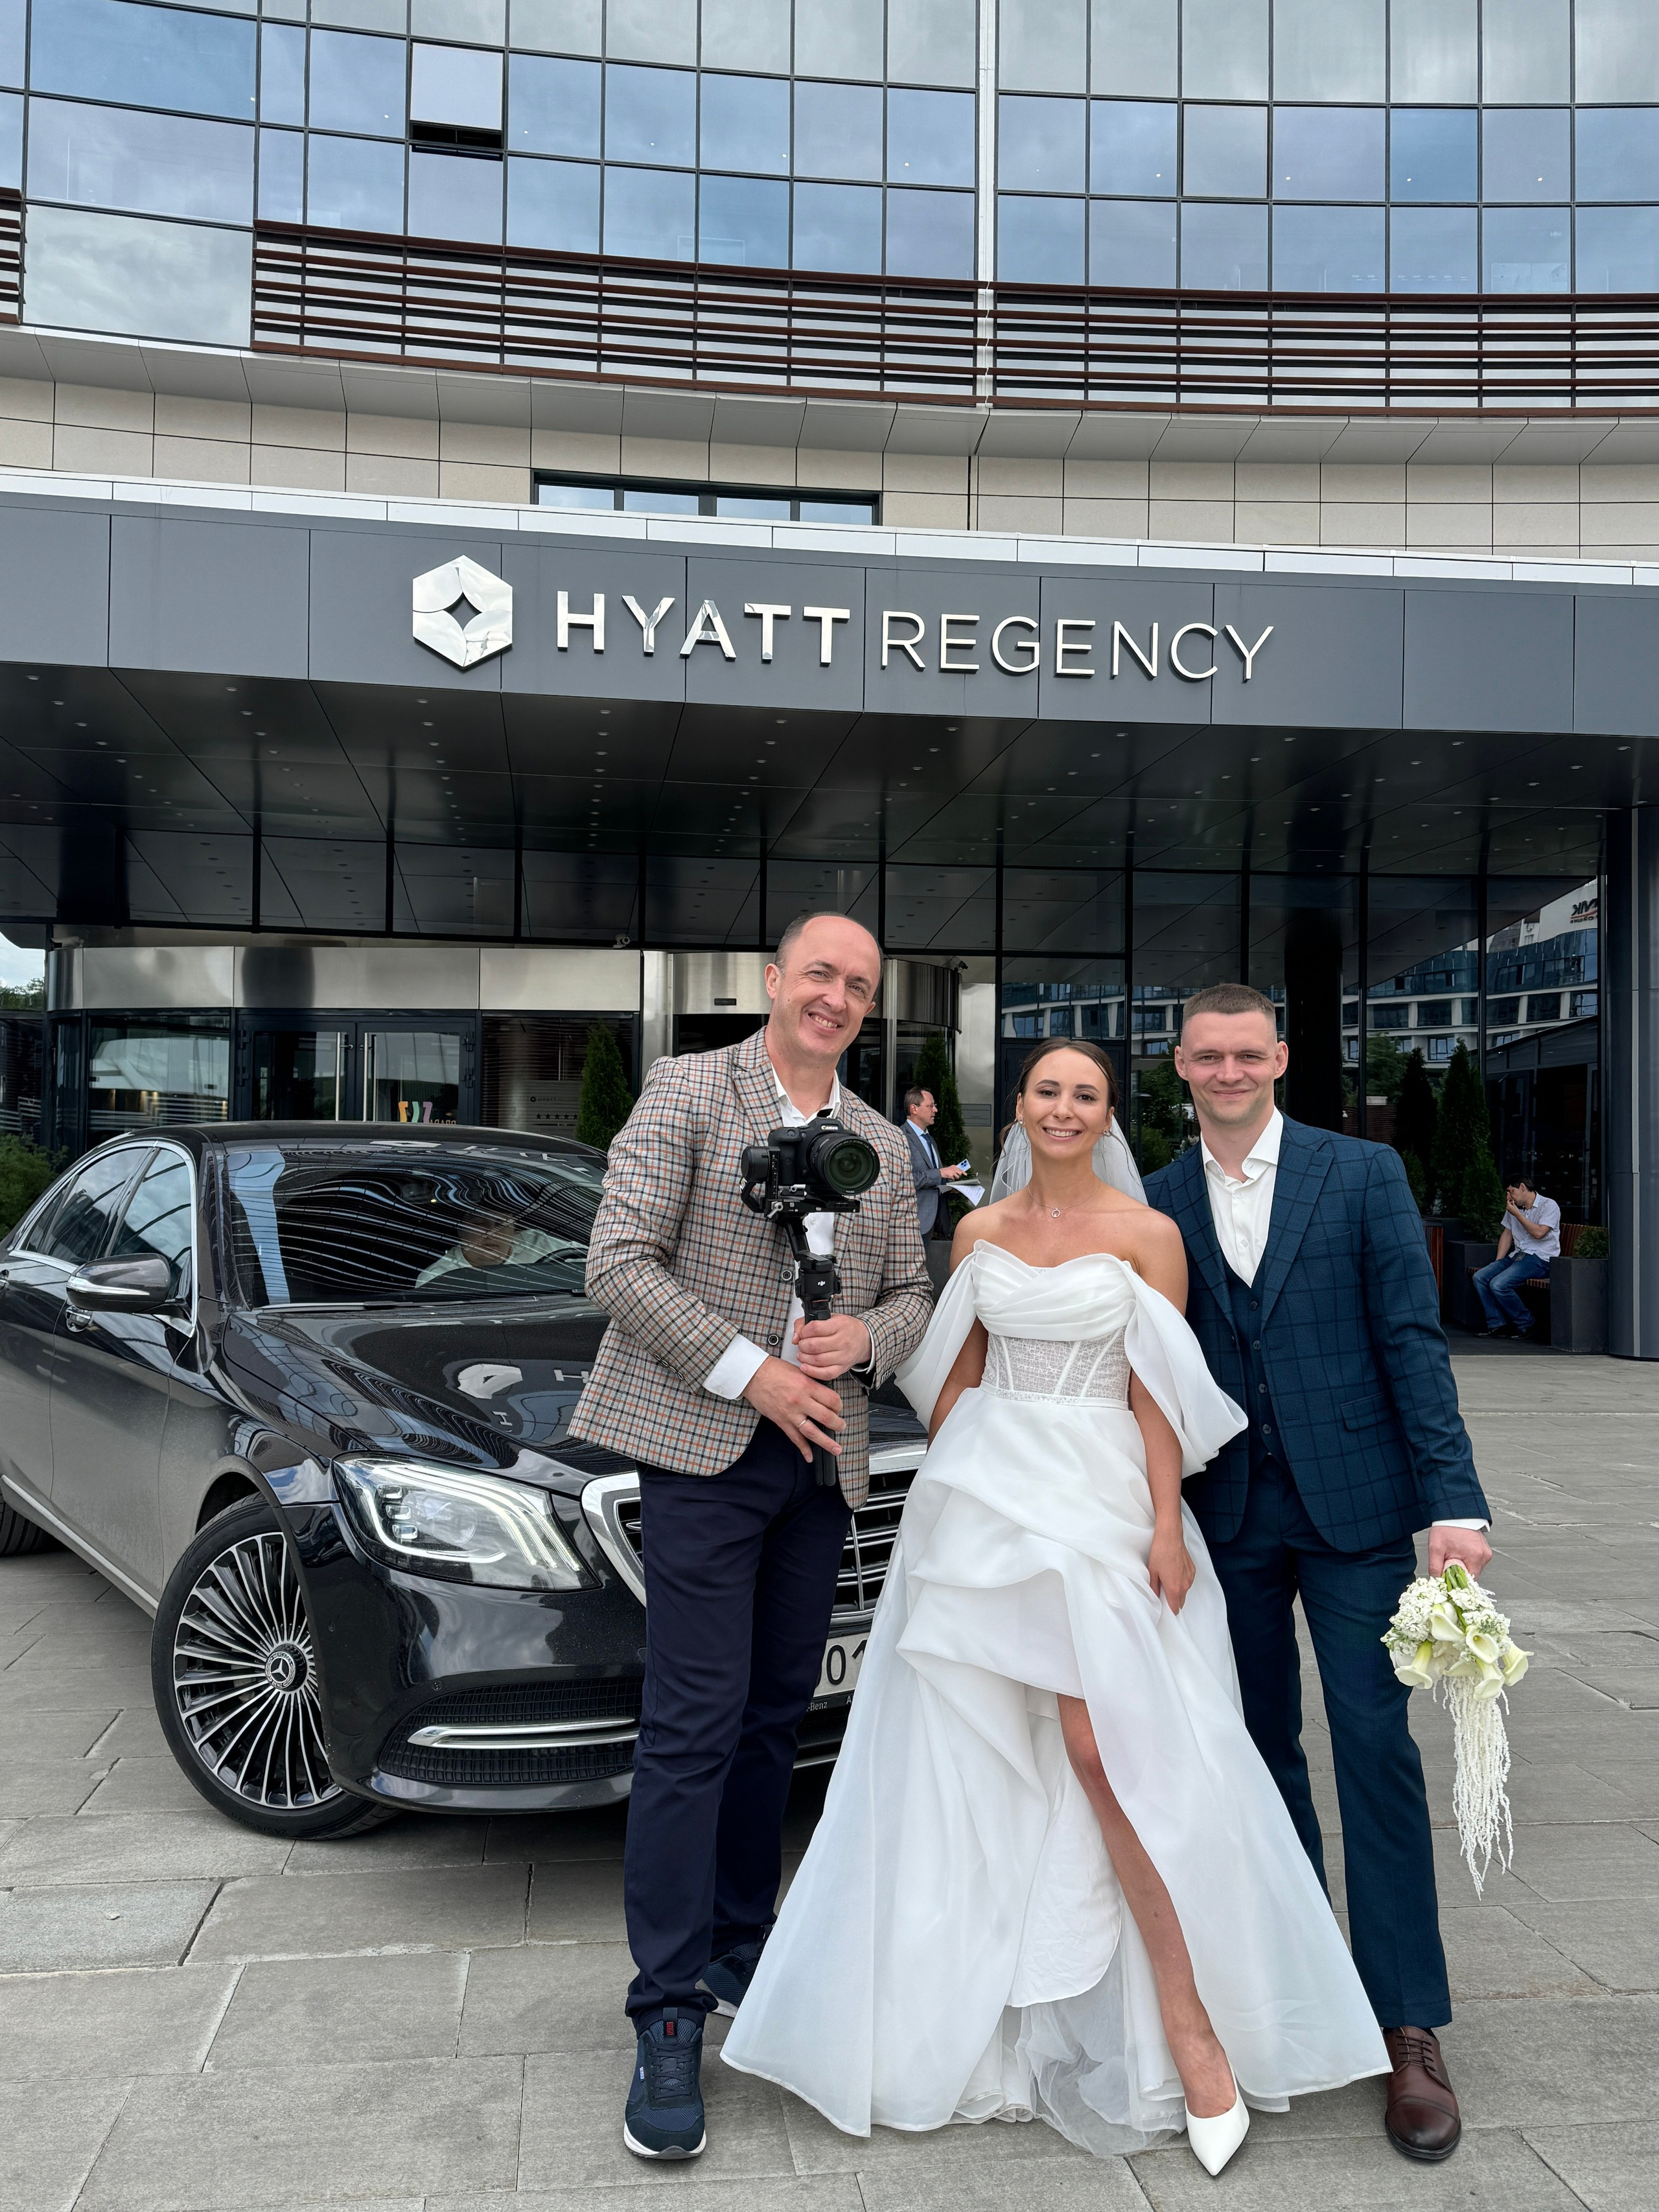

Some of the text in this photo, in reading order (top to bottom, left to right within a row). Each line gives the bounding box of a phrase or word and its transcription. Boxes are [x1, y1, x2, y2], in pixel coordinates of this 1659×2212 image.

[557, 590, 1274, 682] HYATT REGENCY
[806, 1695, 852, 1712] -Benz A
